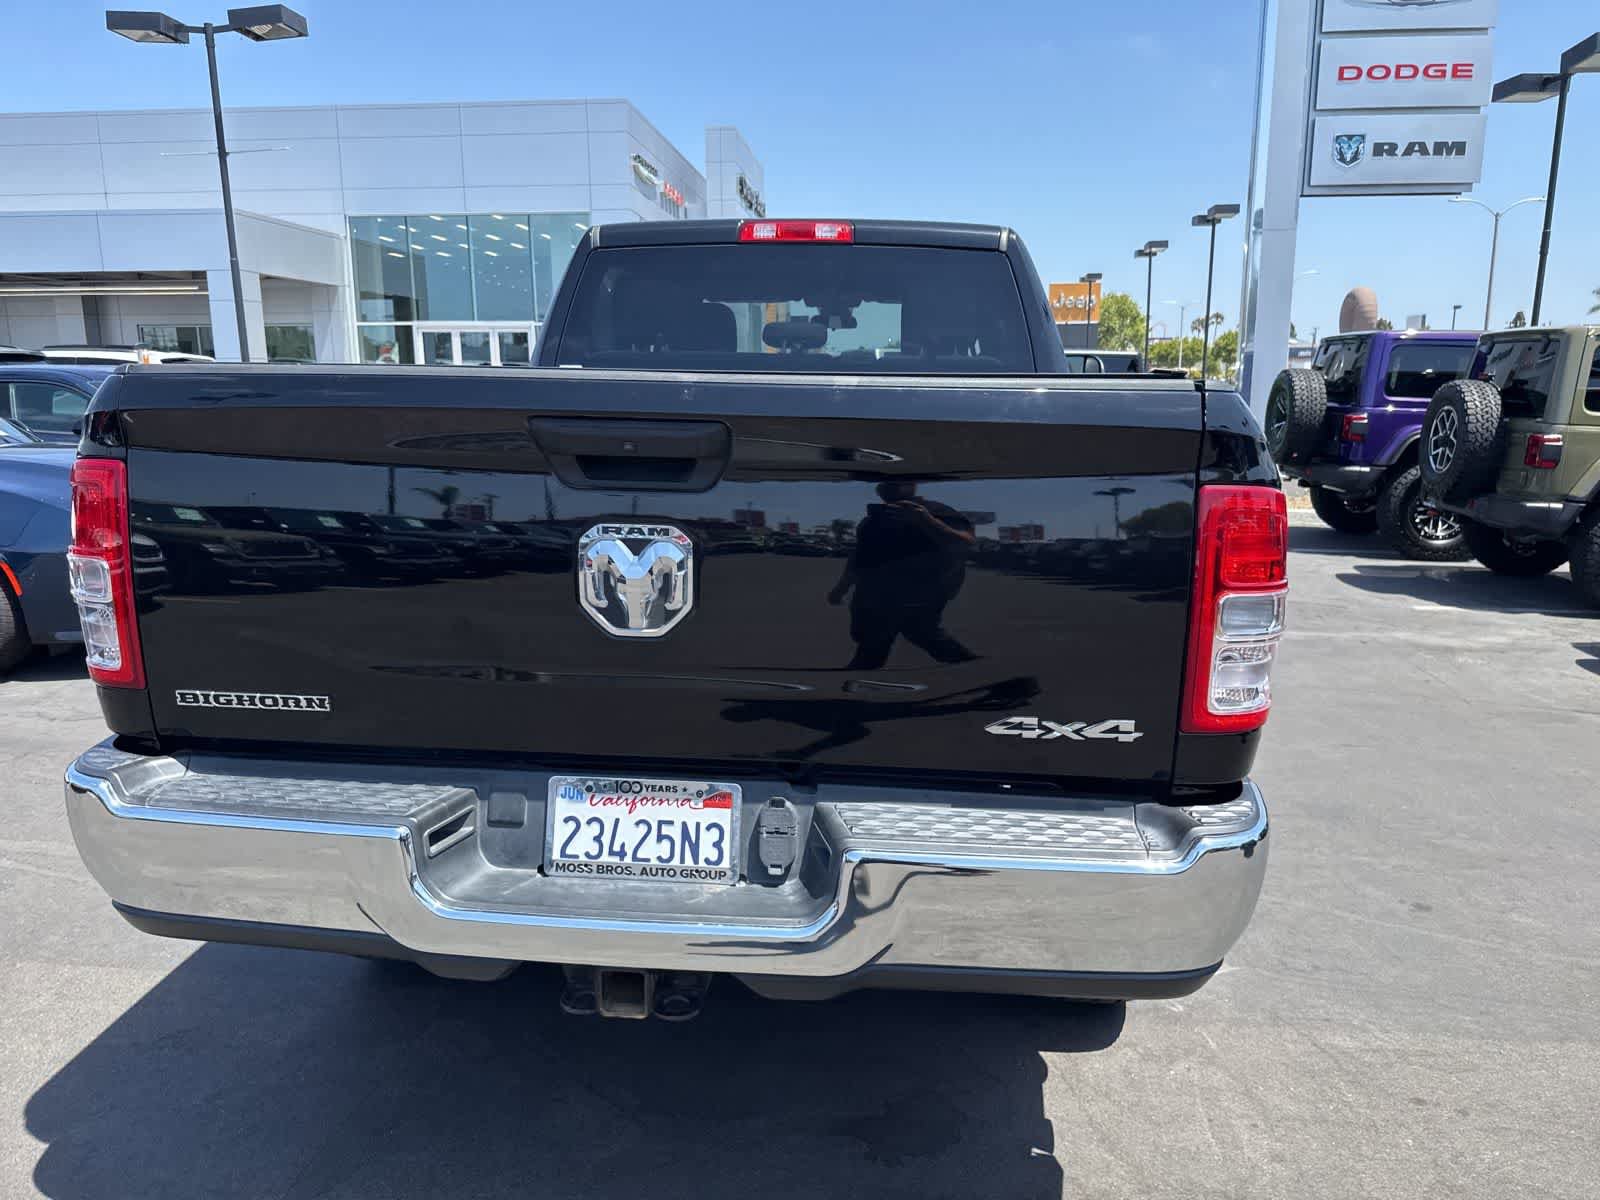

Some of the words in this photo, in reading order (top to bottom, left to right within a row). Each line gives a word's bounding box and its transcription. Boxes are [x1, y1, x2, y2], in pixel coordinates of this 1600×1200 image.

[1337, 63, 1474, 81] DODGE
[1372, 141, 1467, 157] RAM
[1053, 292, 1096, 311] Jeep
[601, 525, 670, 537] RAM
[175, 689, 330, 711] BIGHORN
[560, 786, 584, 801] JUN
[615, 780, 643, 794] 100
[644, 783, 679, 794] YEARS
[559, 815, 726, 867] 23425N3
[555, 862, 593, 874] MOSS
[596, 864, 636, 877] BROS.
[639, 866, 677, 878] AUTO
[680, 868, 727, 881] GROUP
